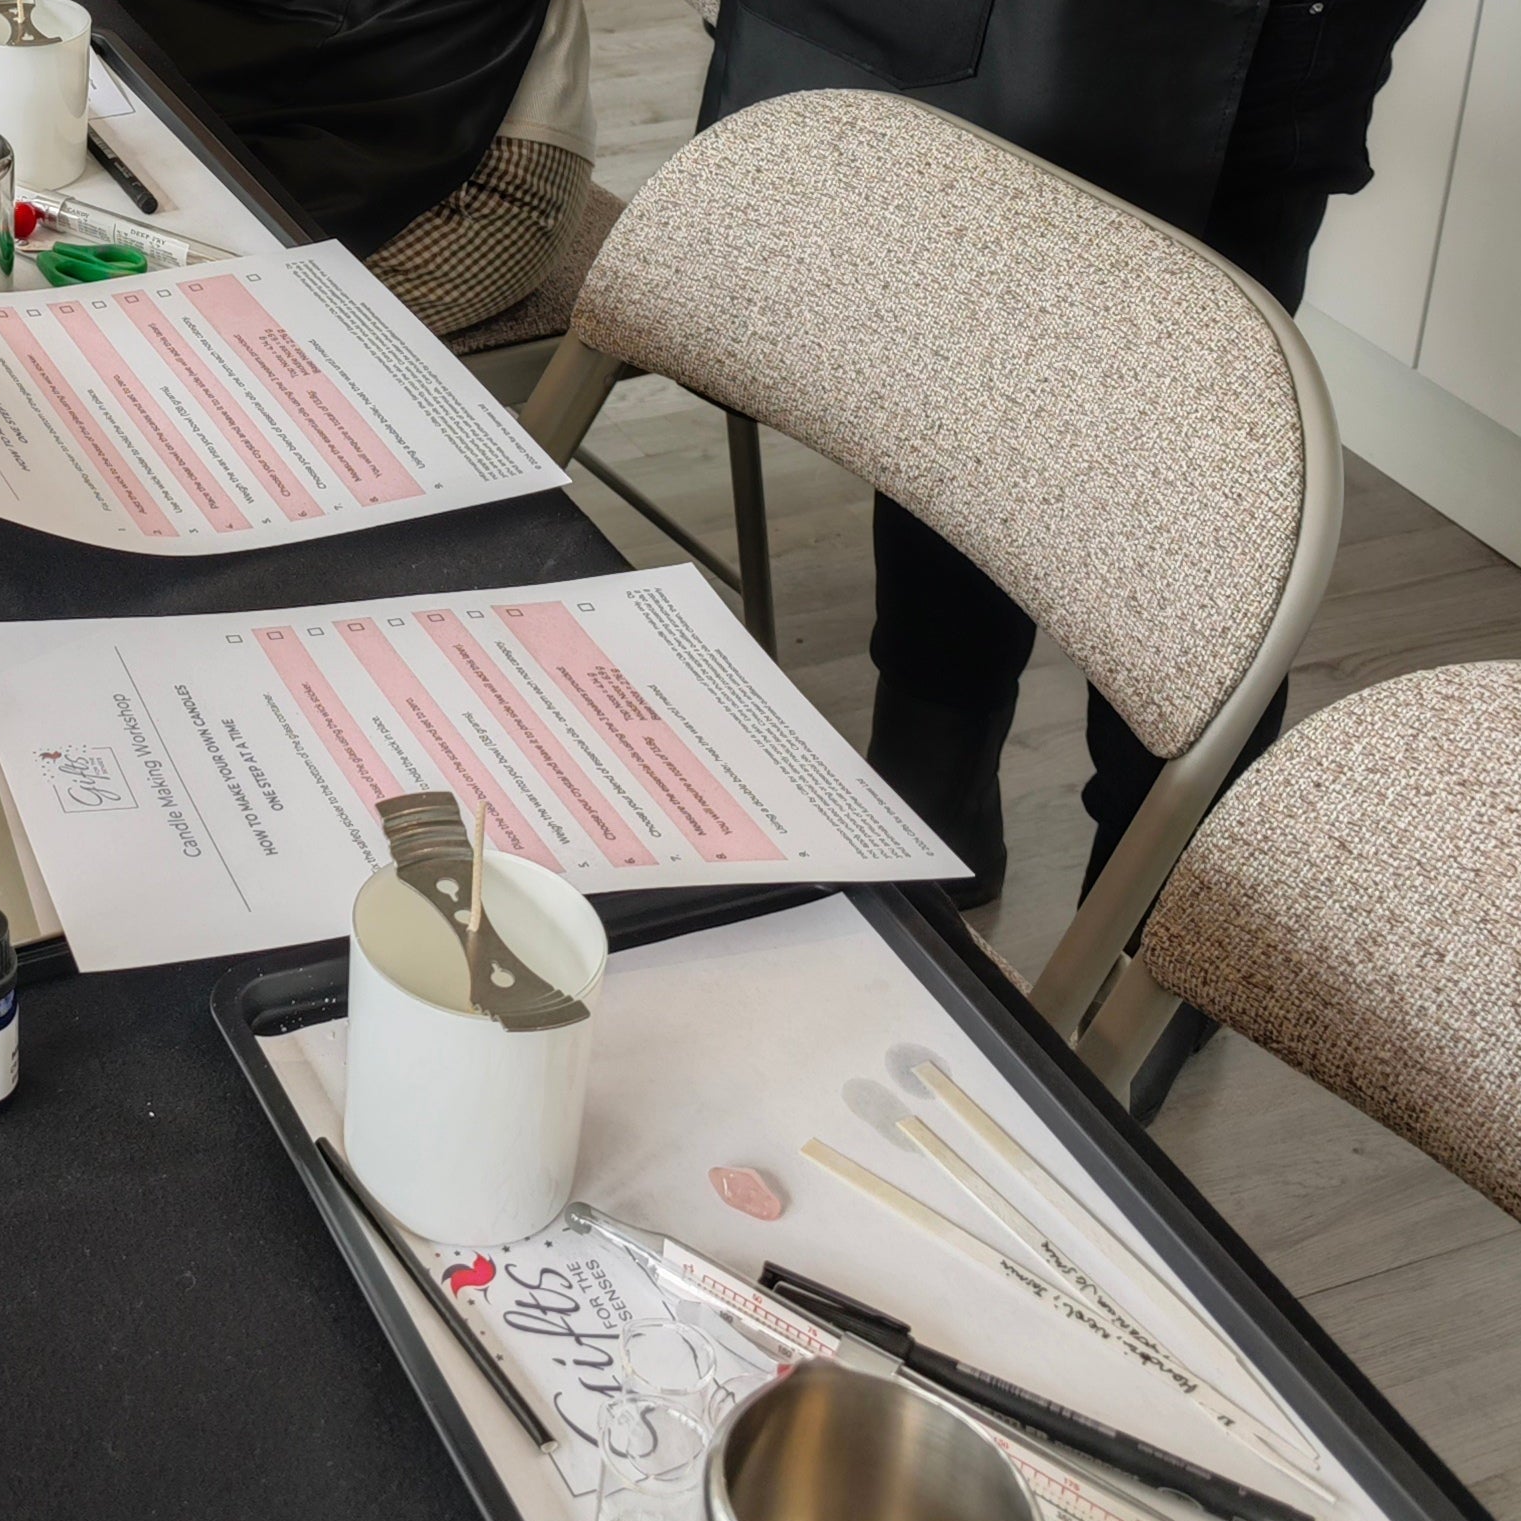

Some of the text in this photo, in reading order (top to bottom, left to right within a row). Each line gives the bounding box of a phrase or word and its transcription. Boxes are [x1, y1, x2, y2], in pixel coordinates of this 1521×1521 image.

[130, 229, 168, 246] DEEP FRY
[58, 753, 121, 807] Gifts
[112, 692, 202, 858] Candle Making Workshop
[173, 683, 279, 856] HOW TO MAKE YOUR OWN CANDLES
[220, 717, 284, 811] ONE STEP AT A TIME
[566, 1261, 617, 1330] FOR THE
[586, 1258, 633, 1322] SENSES
[503, 1263, 656, 1459] Gifts
